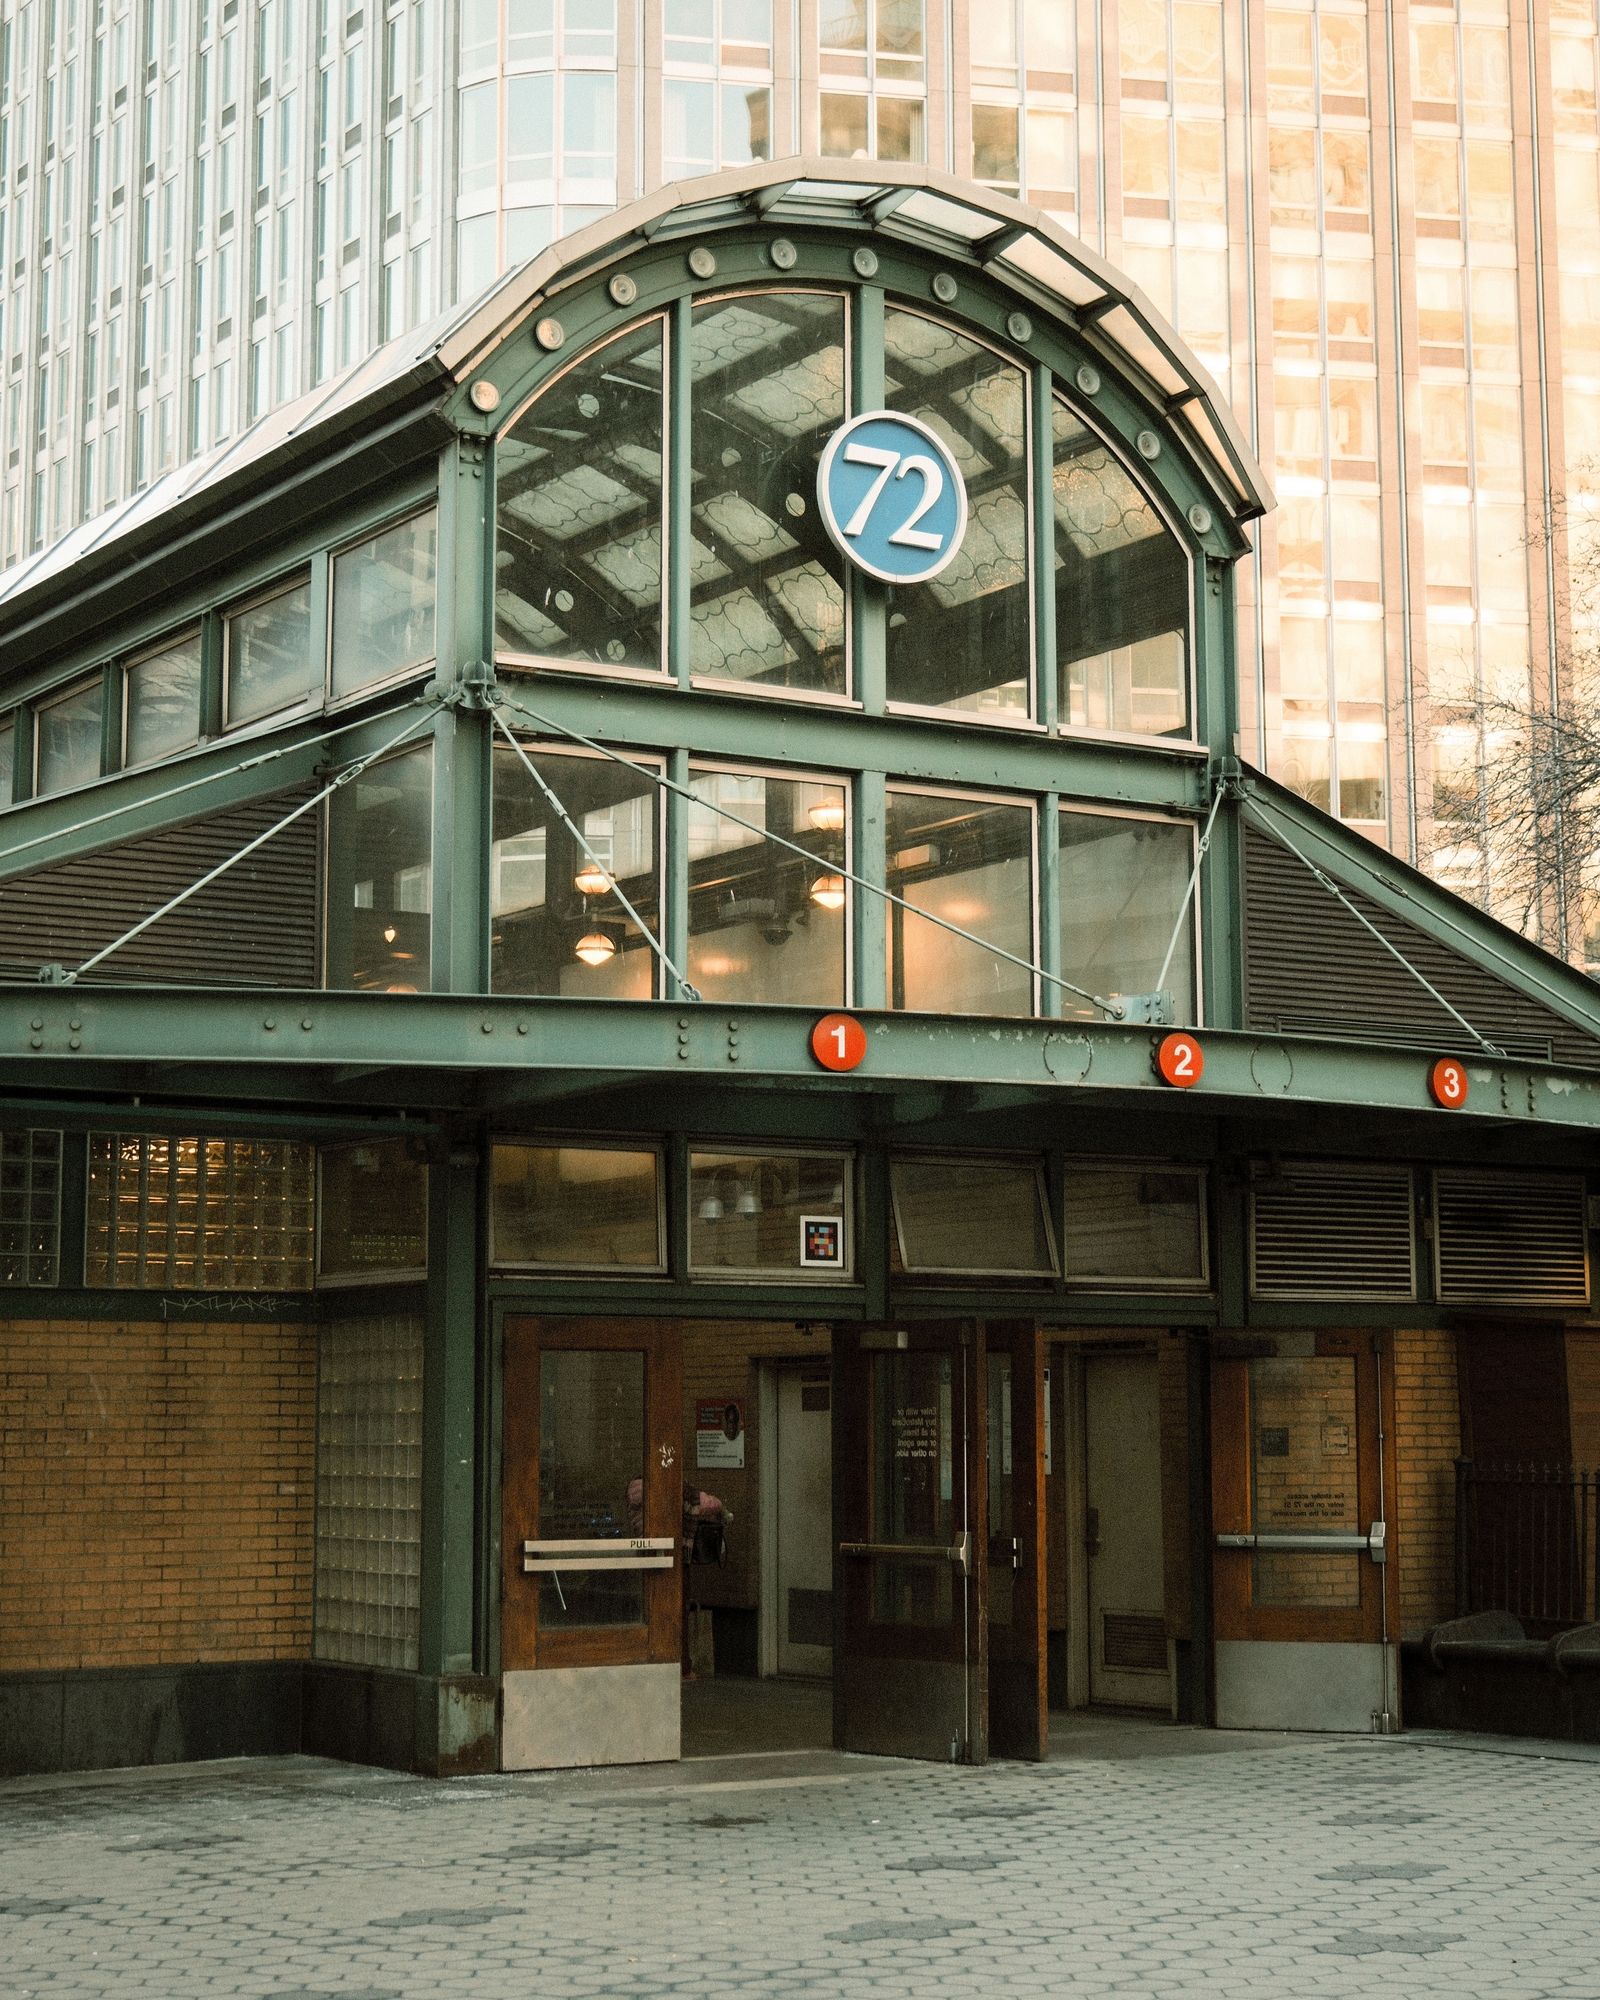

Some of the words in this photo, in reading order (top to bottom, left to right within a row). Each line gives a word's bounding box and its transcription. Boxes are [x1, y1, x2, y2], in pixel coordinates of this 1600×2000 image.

[842, 442, 943, 551] 72
[831, 1025, 845, 1058] 1
[1174, 1044, 1194, 1076] 2
[1444, 1067, 1460, 1098] 3
[630, 1540, 653, 1549] PULL
